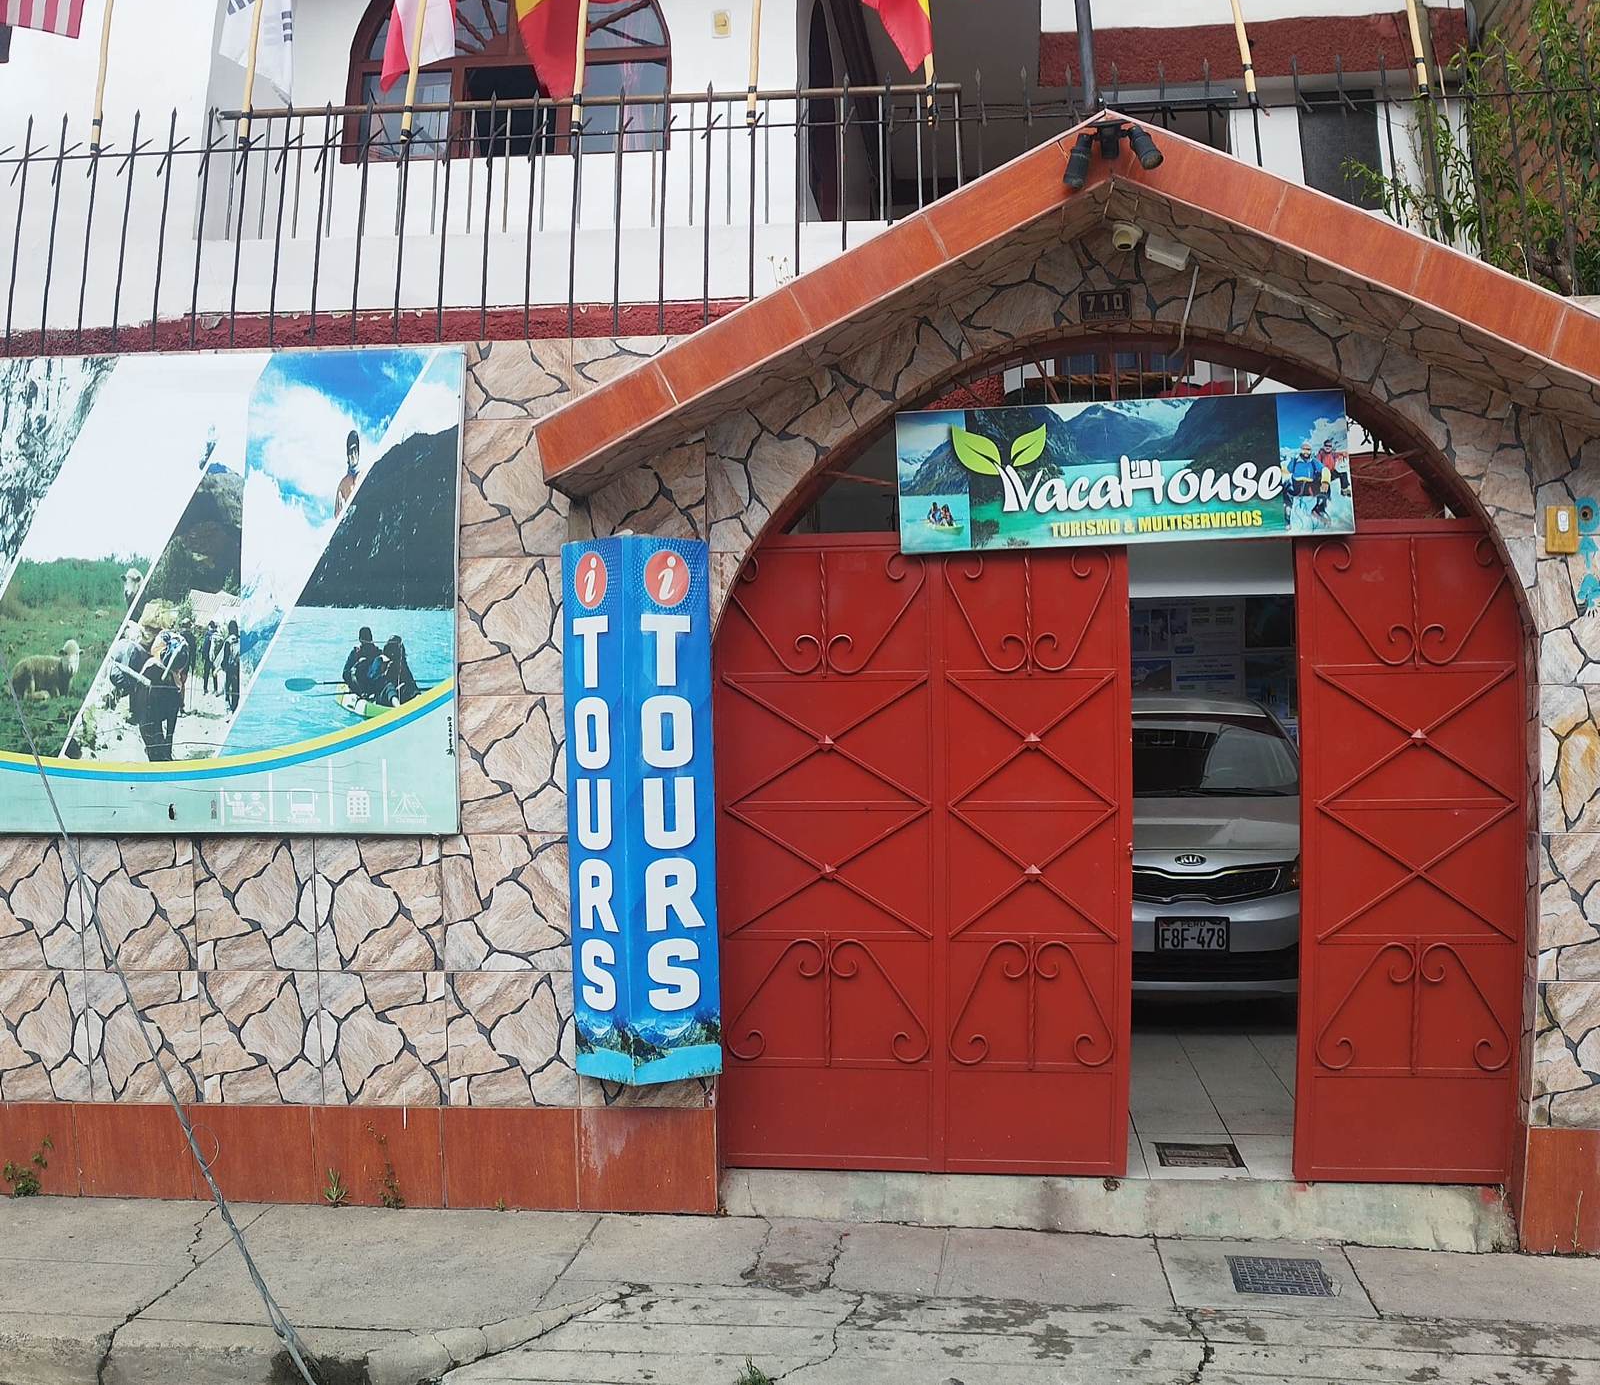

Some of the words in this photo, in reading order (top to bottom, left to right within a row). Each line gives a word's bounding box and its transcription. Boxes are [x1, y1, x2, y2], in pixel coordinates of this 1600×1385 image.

[1086, 294, 1123, 312] 710
[999, 454, 1284, 513] VacaHouse
[1051, 518, 1121, 538] TURISMO
[1124, 521, 1136, 534] &
[1138, 510, 1263, 533] MULTISERVICIOS
[573, 615, 619, 1011] TOURS
[640, 614, 706, 1011] TOURS
[1179, 855, 1202, 864] KIA
[1160, 927, 1225, 948] F8F-478
